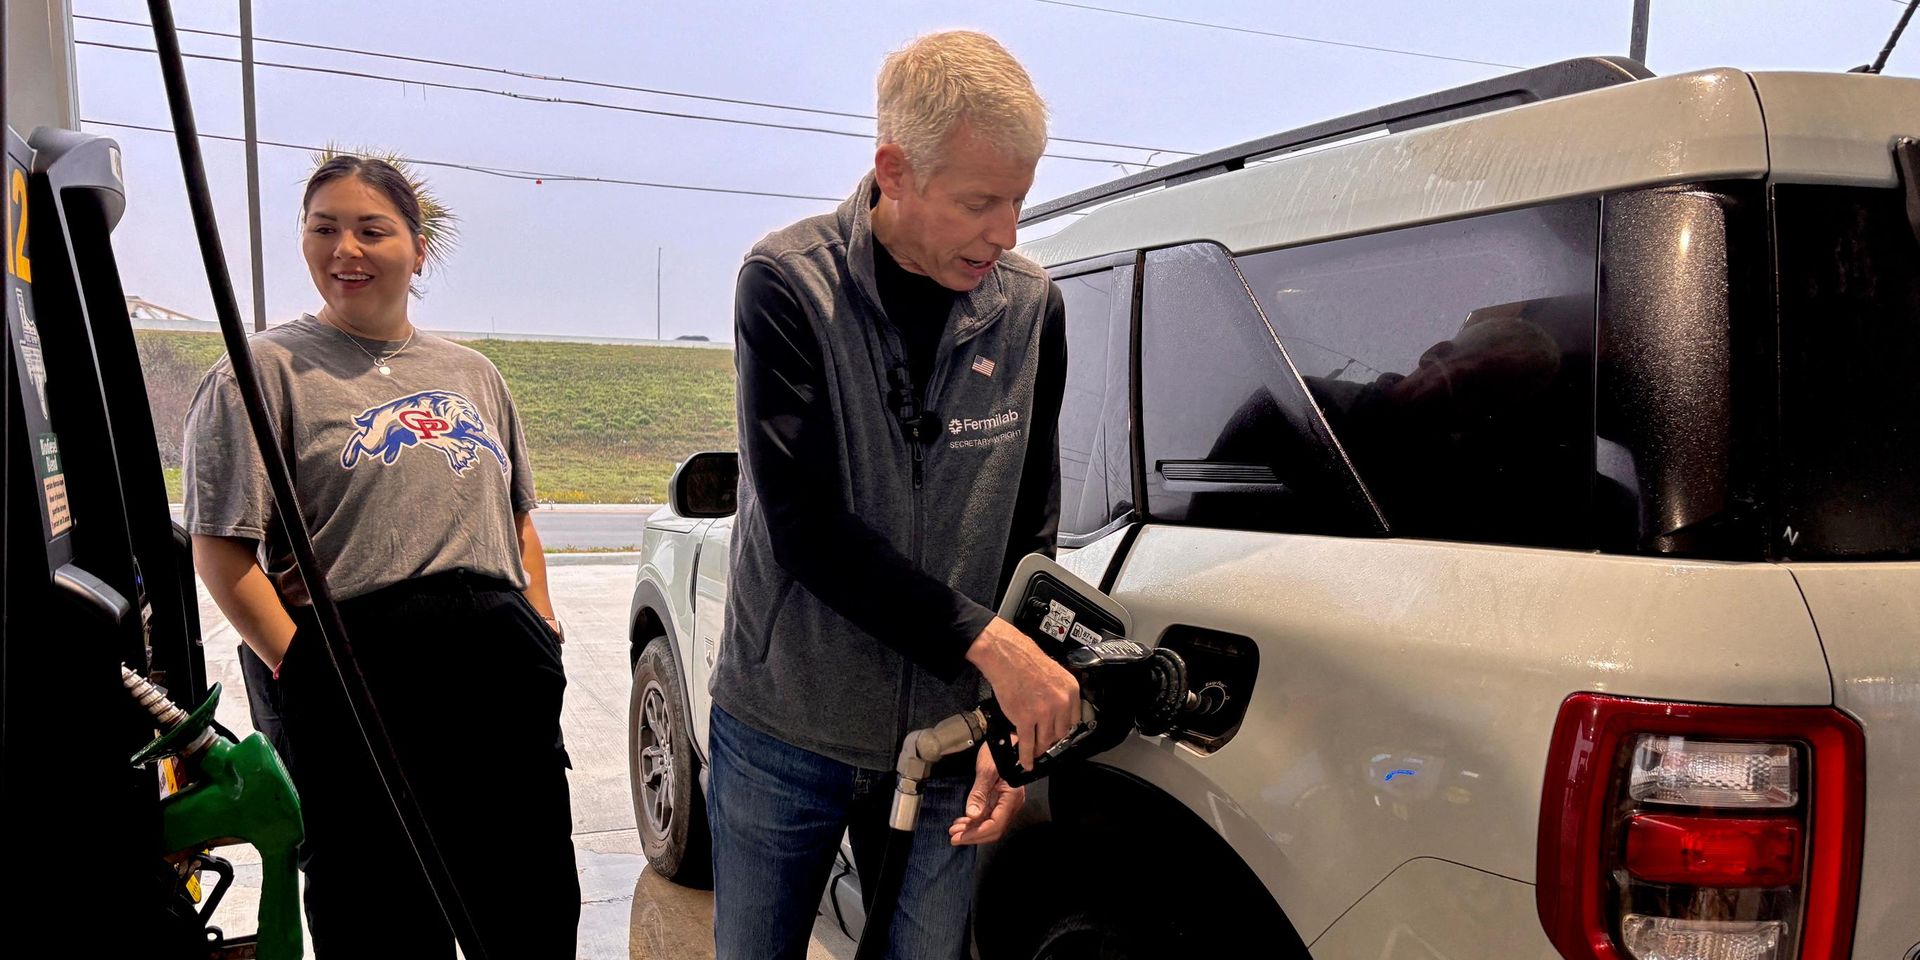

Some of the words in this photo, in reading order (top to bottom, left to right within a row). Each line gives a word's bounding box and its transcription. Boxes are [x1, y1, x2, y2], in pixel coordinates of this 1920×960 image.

[964, 409, 1018, 431] Fermilab
[950, 439, 990, 448] SECRETARY
[993, 429, 1021, 442] WRIGHT
